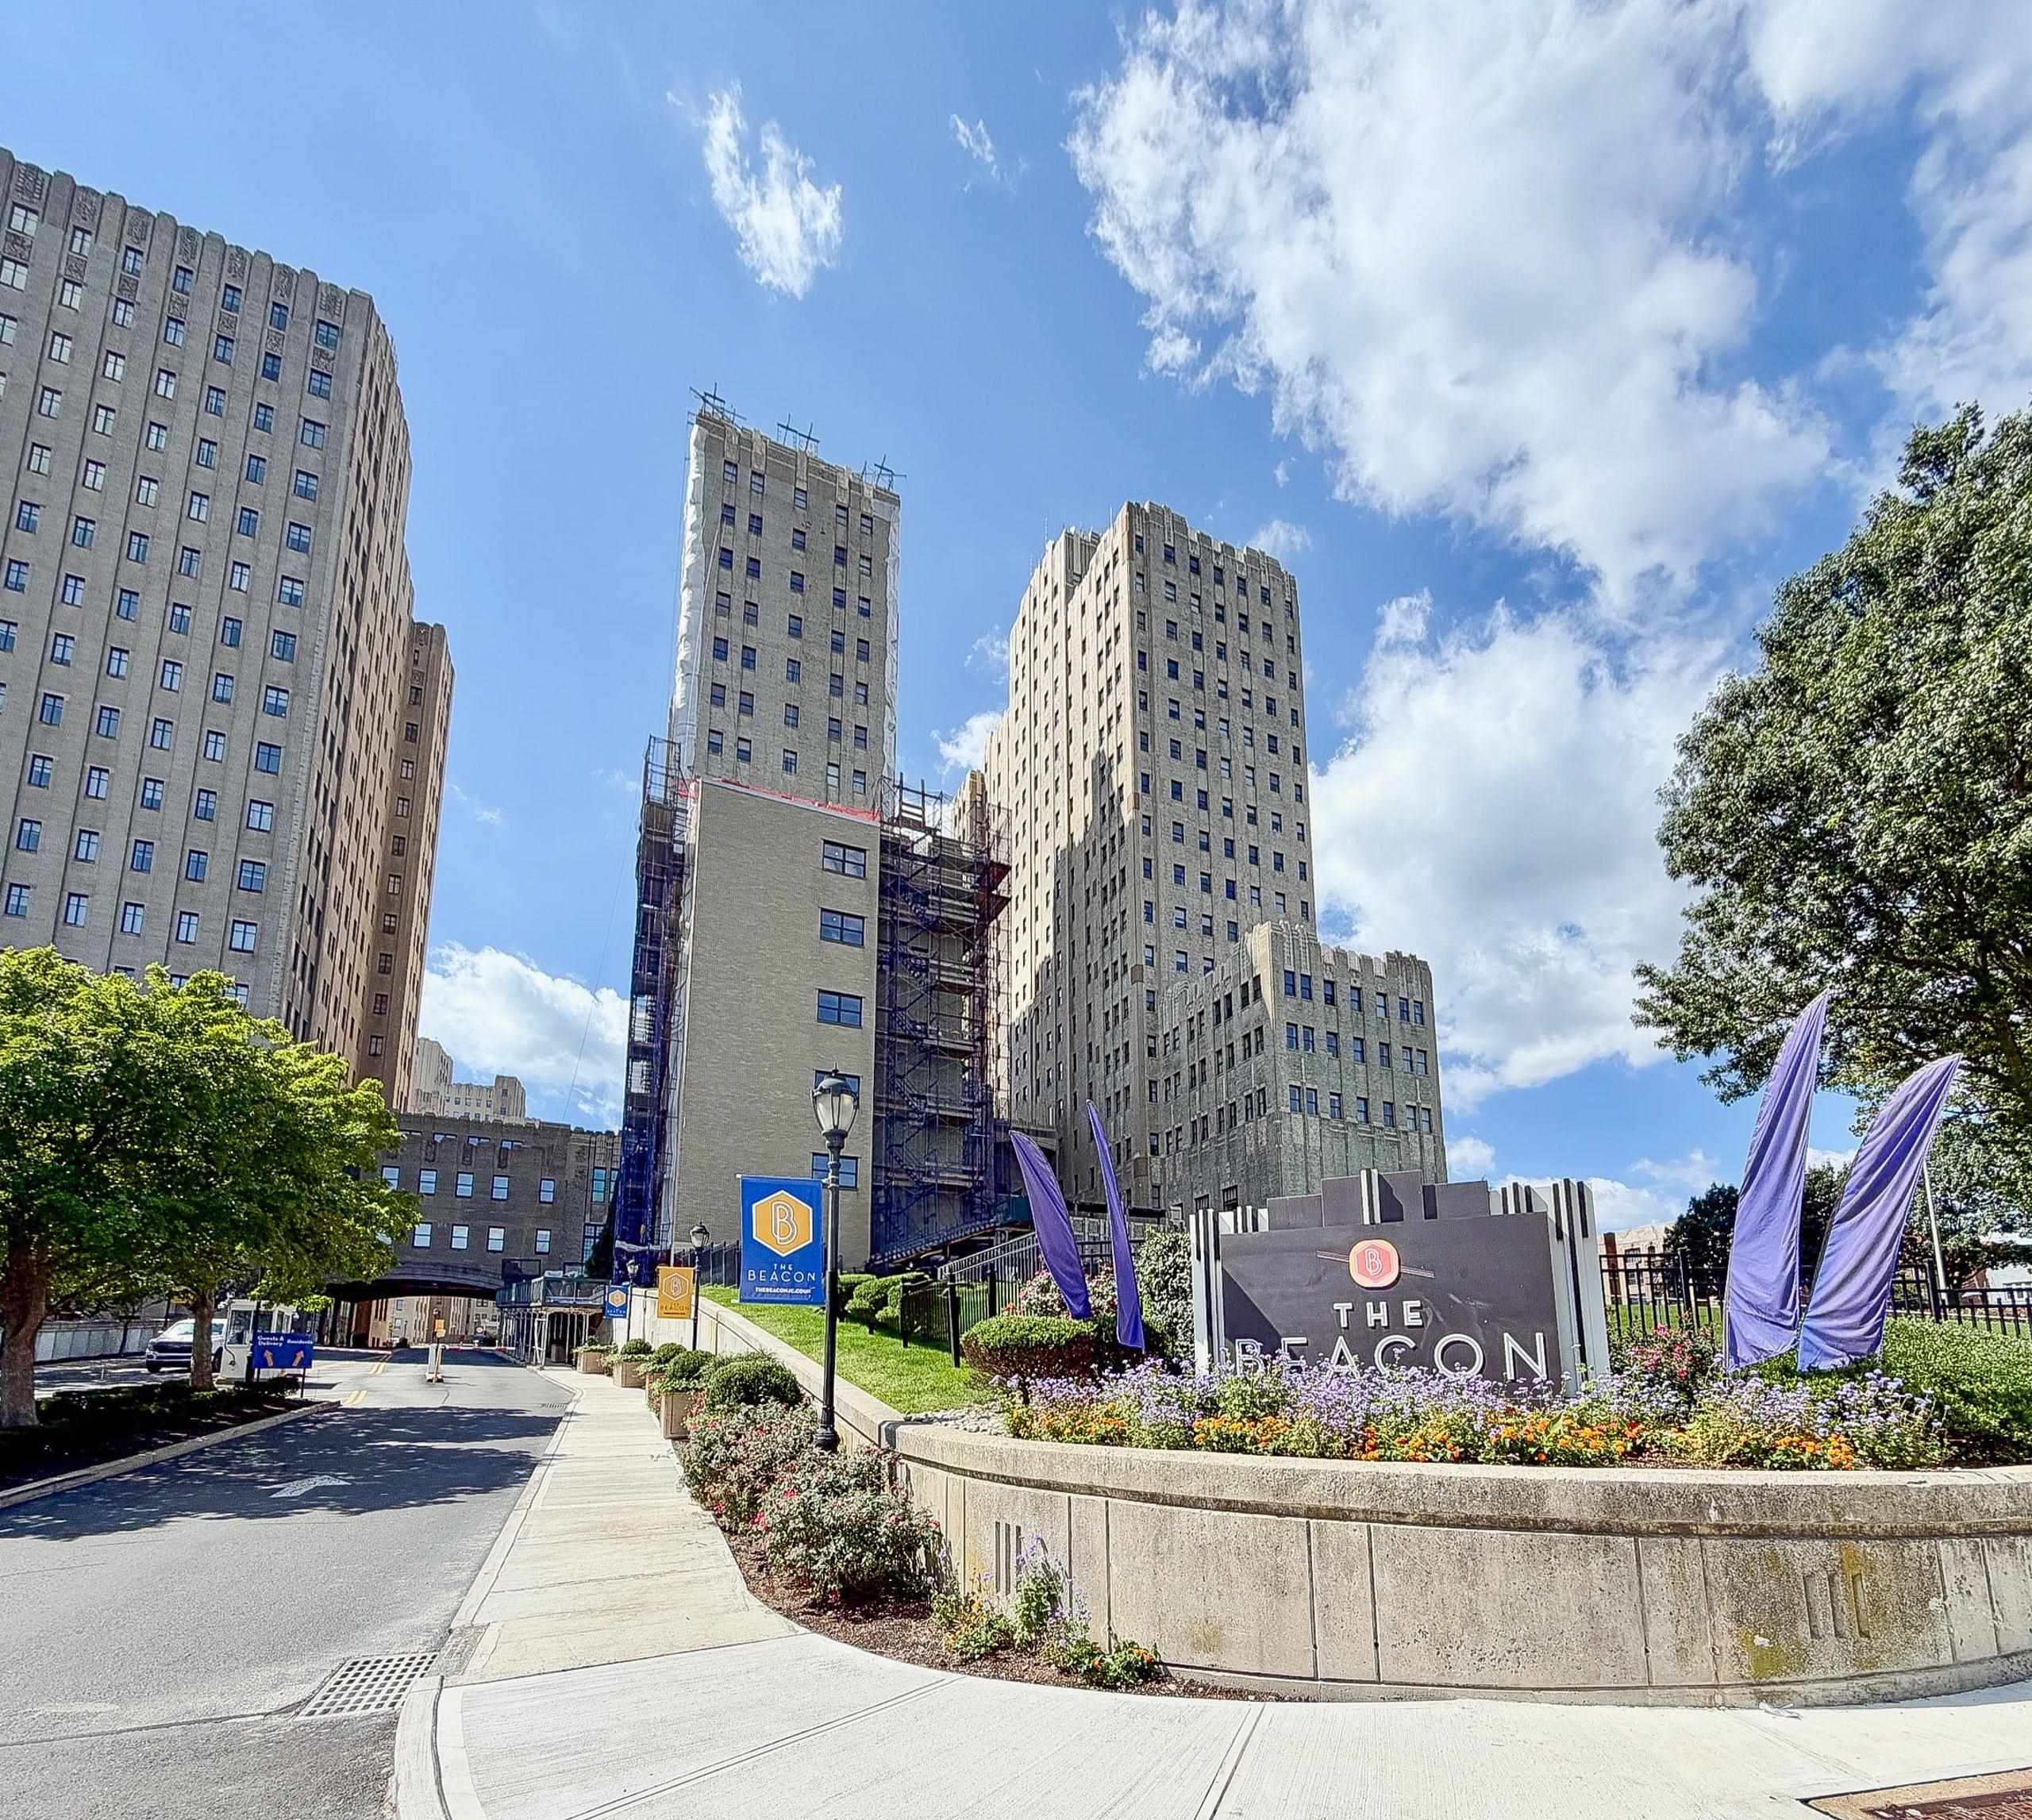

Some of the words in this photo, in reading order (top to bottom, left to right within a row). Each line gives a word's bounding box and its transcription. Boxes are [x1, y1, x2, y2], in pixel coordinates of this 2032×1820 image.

[748, 1269, 816, 1283] BEACON
[1333, 1300, 1424, 1329] THE
[1235, 1332, 1548, 1382] BEACON
